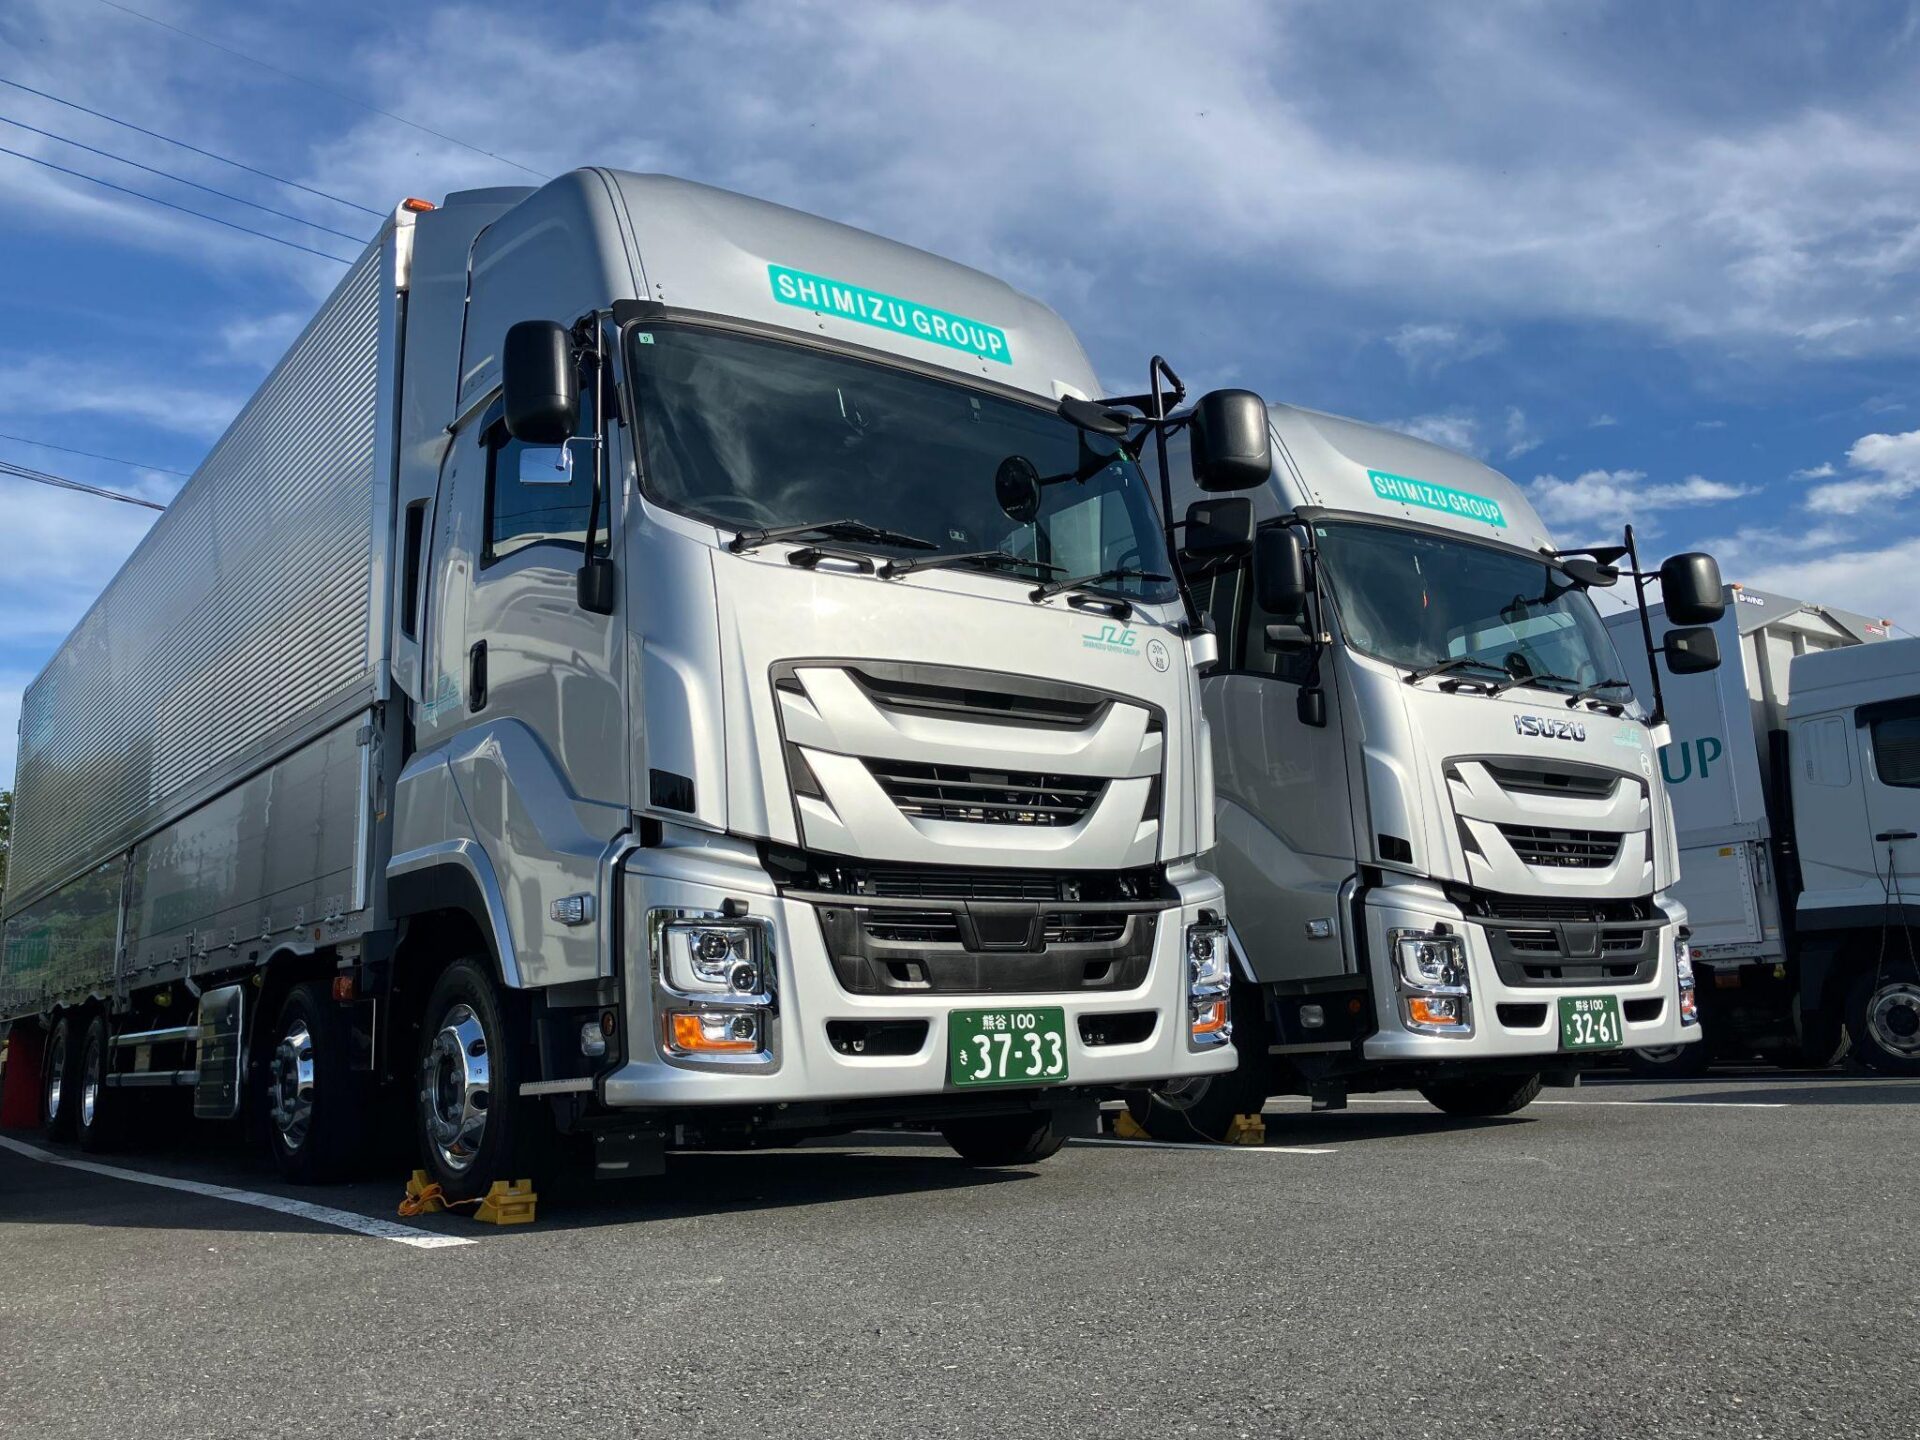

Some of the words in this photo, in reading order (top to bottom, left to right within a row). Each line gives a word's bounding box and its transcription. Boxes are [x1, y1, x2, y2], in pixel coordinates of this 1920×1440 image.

[777, 273, 906, 329] SHIMIZU
[911, 309, 1003, 355] GROUP
[1374, 475, 1448, 508] SHIMIZU
[1448, 493, 1500, 522] GROUP
[1513, 714, 1586, 742] ISUZU
[1658, 736, 1722, 784] UP
[982, 1014, 1007, 1030] 熊谷
[1010, 1013, 1035, 1030] 100
[1590, 999, 1603, 1011] 100
[1571, 1011, 1618, 1044] 32-61
[972, 1031, 1063, 1079] 37-33
